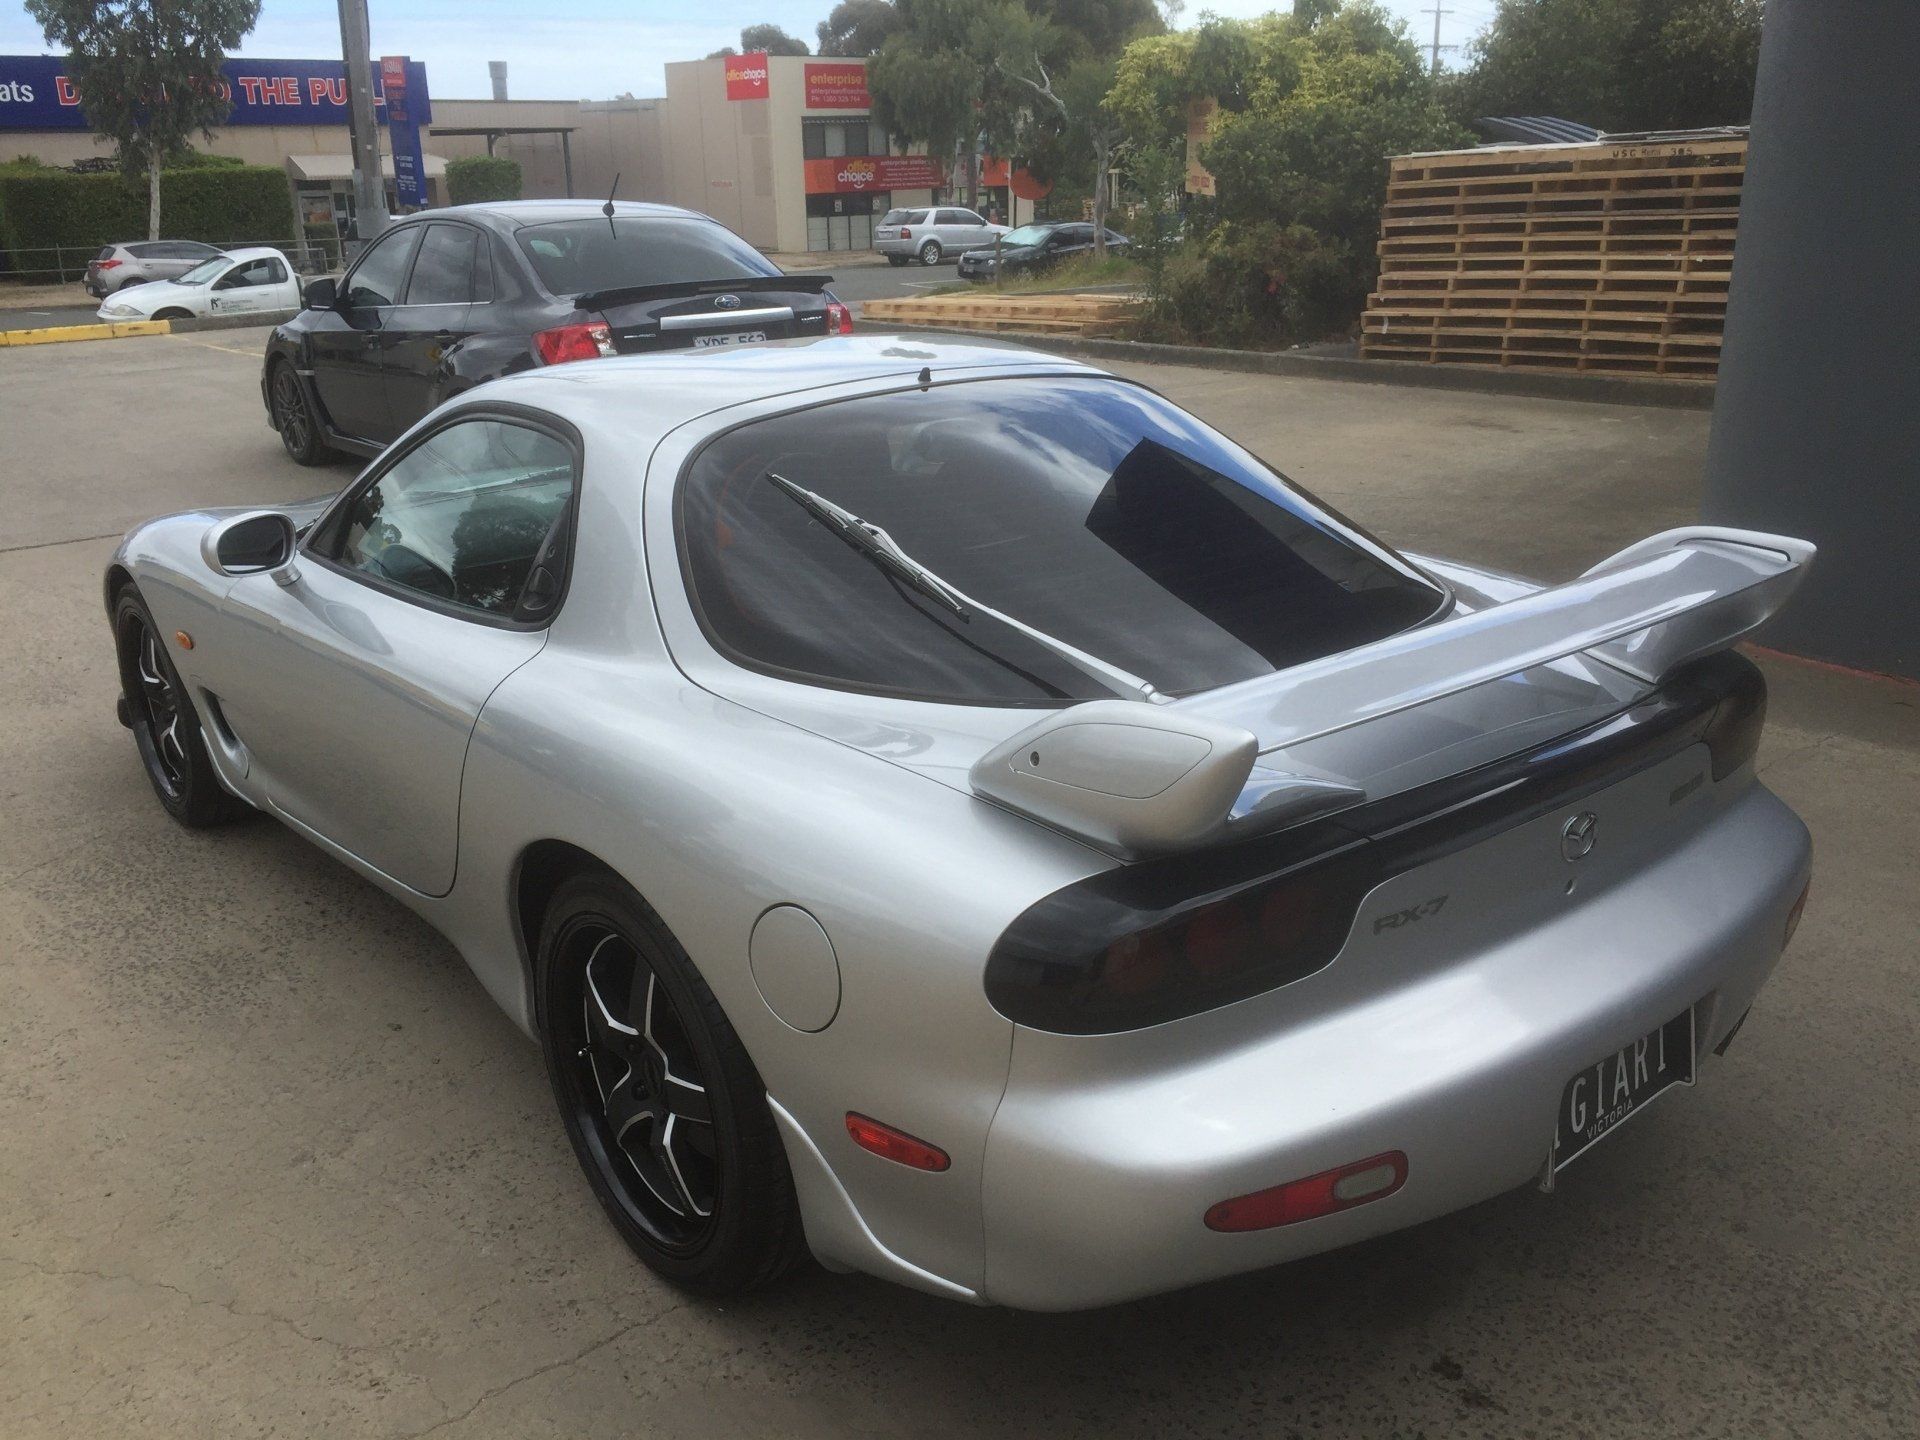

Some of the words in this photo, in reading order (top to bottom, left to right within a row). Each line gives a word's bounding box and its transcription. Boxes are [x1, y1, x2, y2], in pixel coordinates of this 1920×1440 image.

[238, 76, 301, 106] THE
[837, 170, 874, 183] choice
[1373, 894, 1449, 936] RX-7
[1587, 1099, 1634, 1139] VICTORIA
